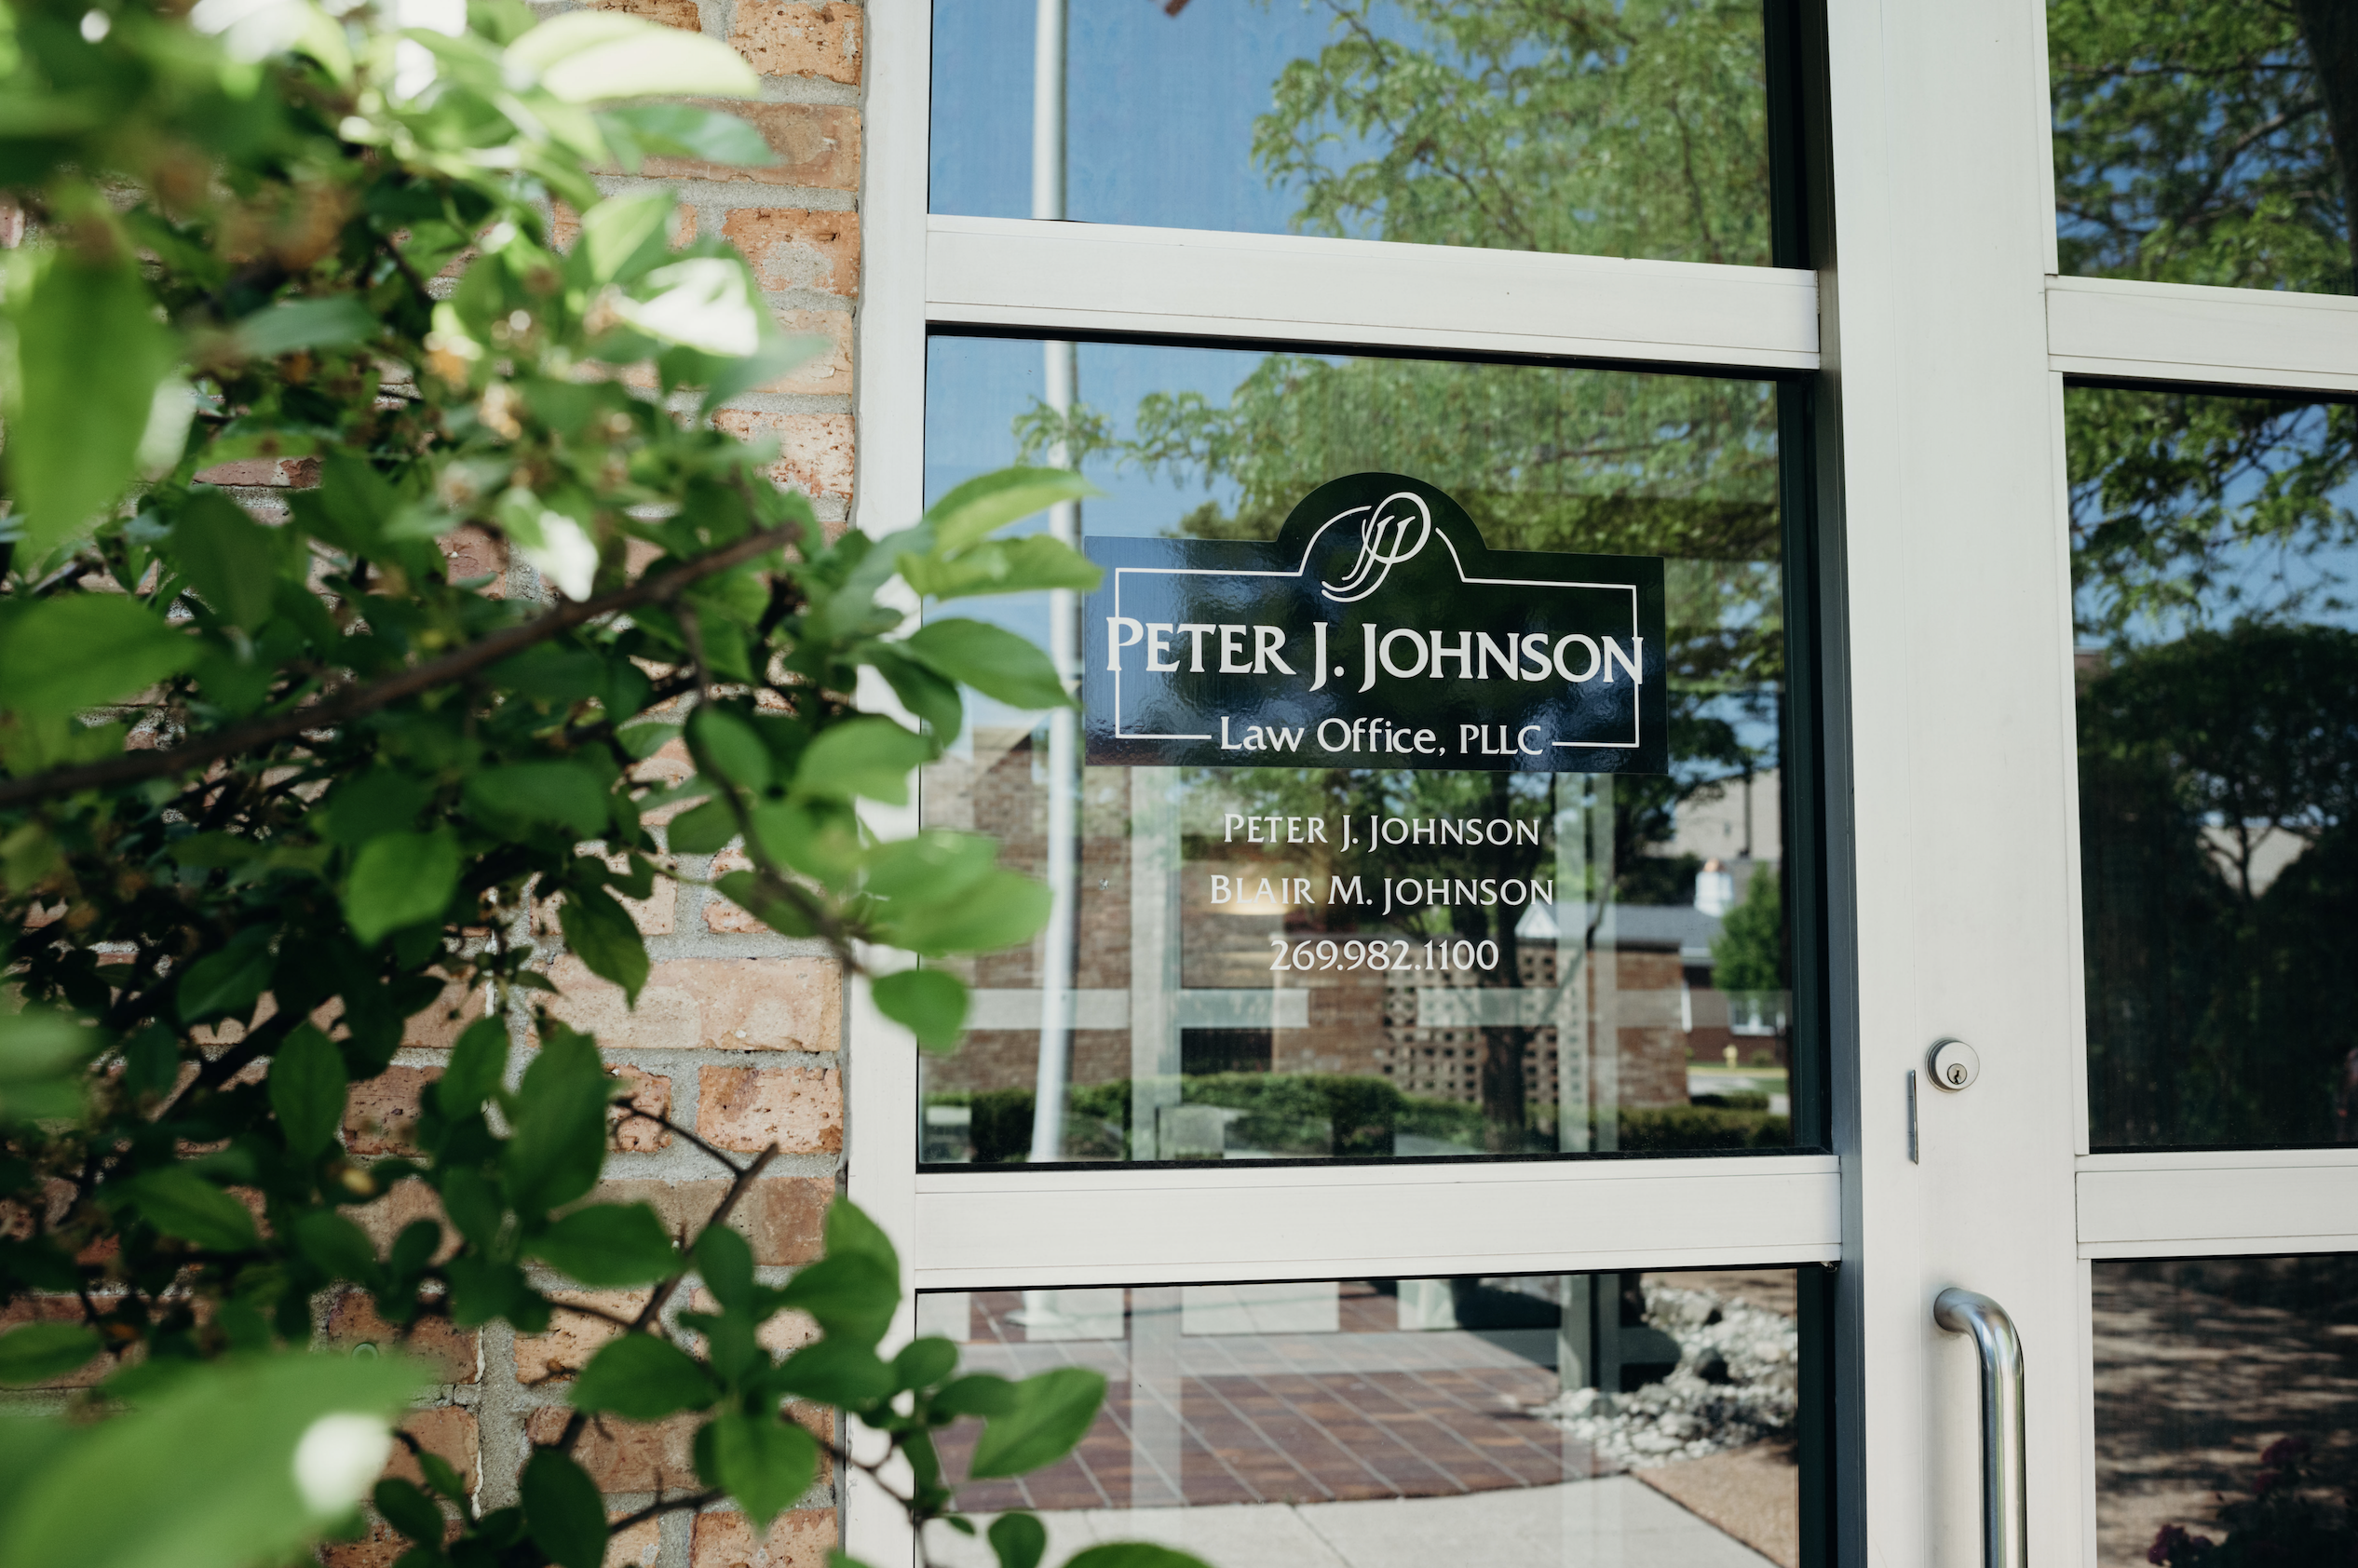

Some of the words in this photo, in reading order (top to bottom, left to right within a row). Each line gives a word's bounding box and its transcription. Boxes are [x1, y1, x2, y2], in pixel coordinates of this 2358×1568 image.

[1106, 617, 1296, 675] PETER
[1309, 622, 1345, 692] J.
[1358, 623, 1644, 693] JOHNSON
[1220, 717, 1305, 750] Law
[1317, 717, 1445, 757] Office,
[1460, 725, 1543, 755] PLLC
[1224, 814, 1327, 844] PETER
[1339, 815, 1359, 852] J.
[1367, 815, 1540, 853] JOHNSON
[1210, 874, 1315, 904] BLAIR
[1328, 875, 1373, 905] M.
[1382, 877, 1553, 915] JOHNSON
[1269, 939, 1499, 971] 269.982.1100
